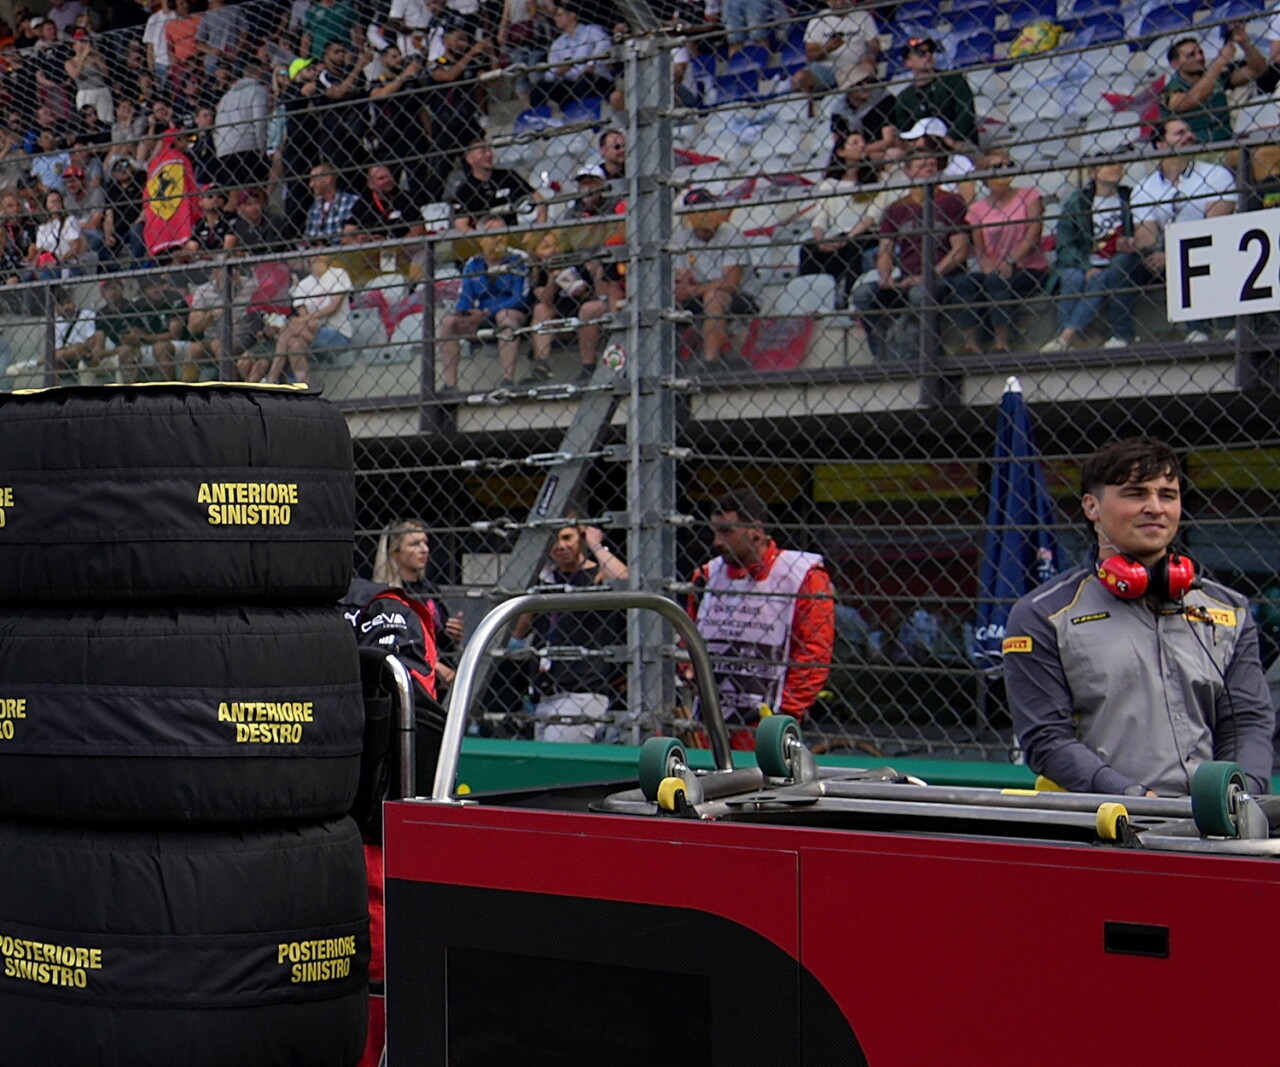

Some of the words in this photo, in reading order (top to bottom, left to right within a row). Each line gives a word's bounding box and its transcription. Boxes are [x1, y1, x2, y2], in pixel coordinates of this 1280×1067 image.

[1179, 234, 1212, 309] F
[1238, 228, 1280, 302] 2
[198, 483, 299, 504] ANTERIORE
[208, 504, 291, 525] SINISTRO
[218, 702, 314, 722] ANTERIORE
[236, 723, 303, 744] DESTRO
[277, 935, 356, 964] POSTERIORE
[4, 957, 87, 988] SINISTRO
[291, 957, 350, 983] SINISTRO
